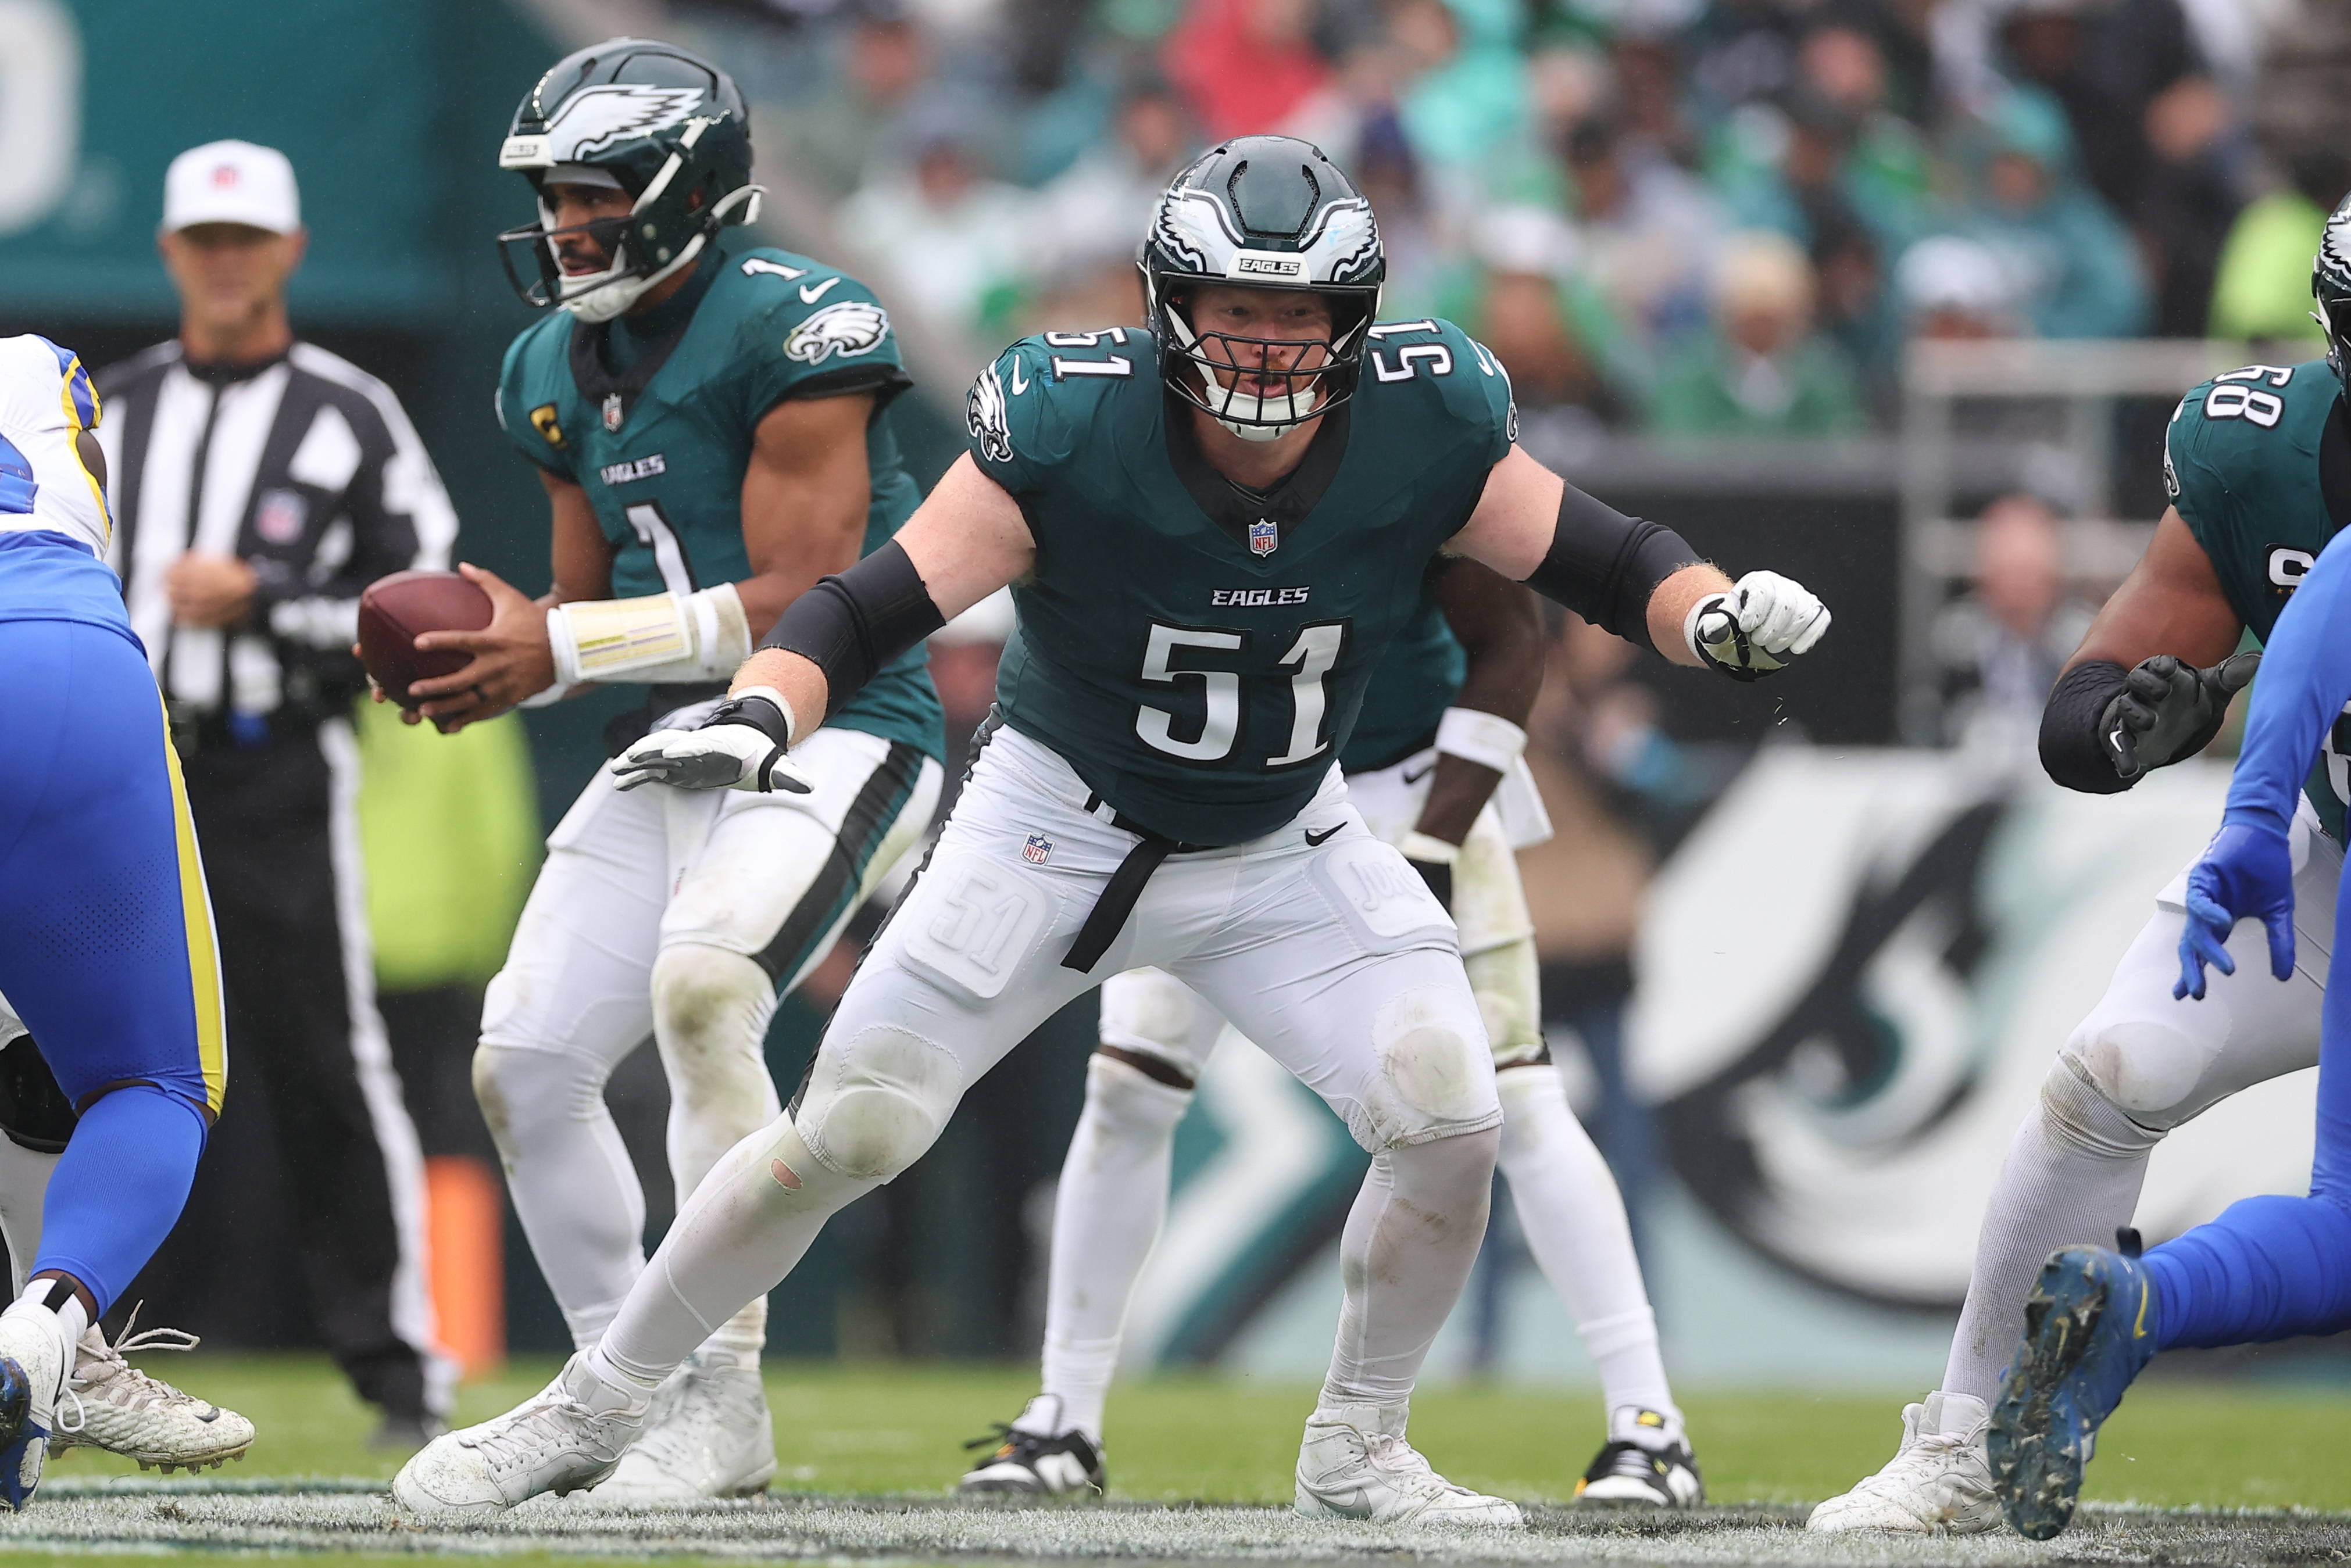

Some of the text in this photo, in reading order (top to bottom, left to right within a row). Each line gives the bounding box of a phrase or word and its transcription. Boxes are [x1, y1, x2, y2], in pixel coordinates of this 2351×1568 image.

[740, 257, 808, 281] 1
[1239, 259, 1300, 275] EAGLES
[1045, 326, 1132, 381] 51
[1367, 320, 1452, 383] 51
[2206, 364, 2294, 428] 68
[626, 503, 693, 597] 1
[1254, 536, 1274, 550] NFL
[2268, 547, 2316, 586] C
[1212, 586, 1310, 606] EAGLES
[1135, 622, 1344, 766] 51
[1025, 844, 1045, 864] NFL
[927, 867, 1030, 976] 51
